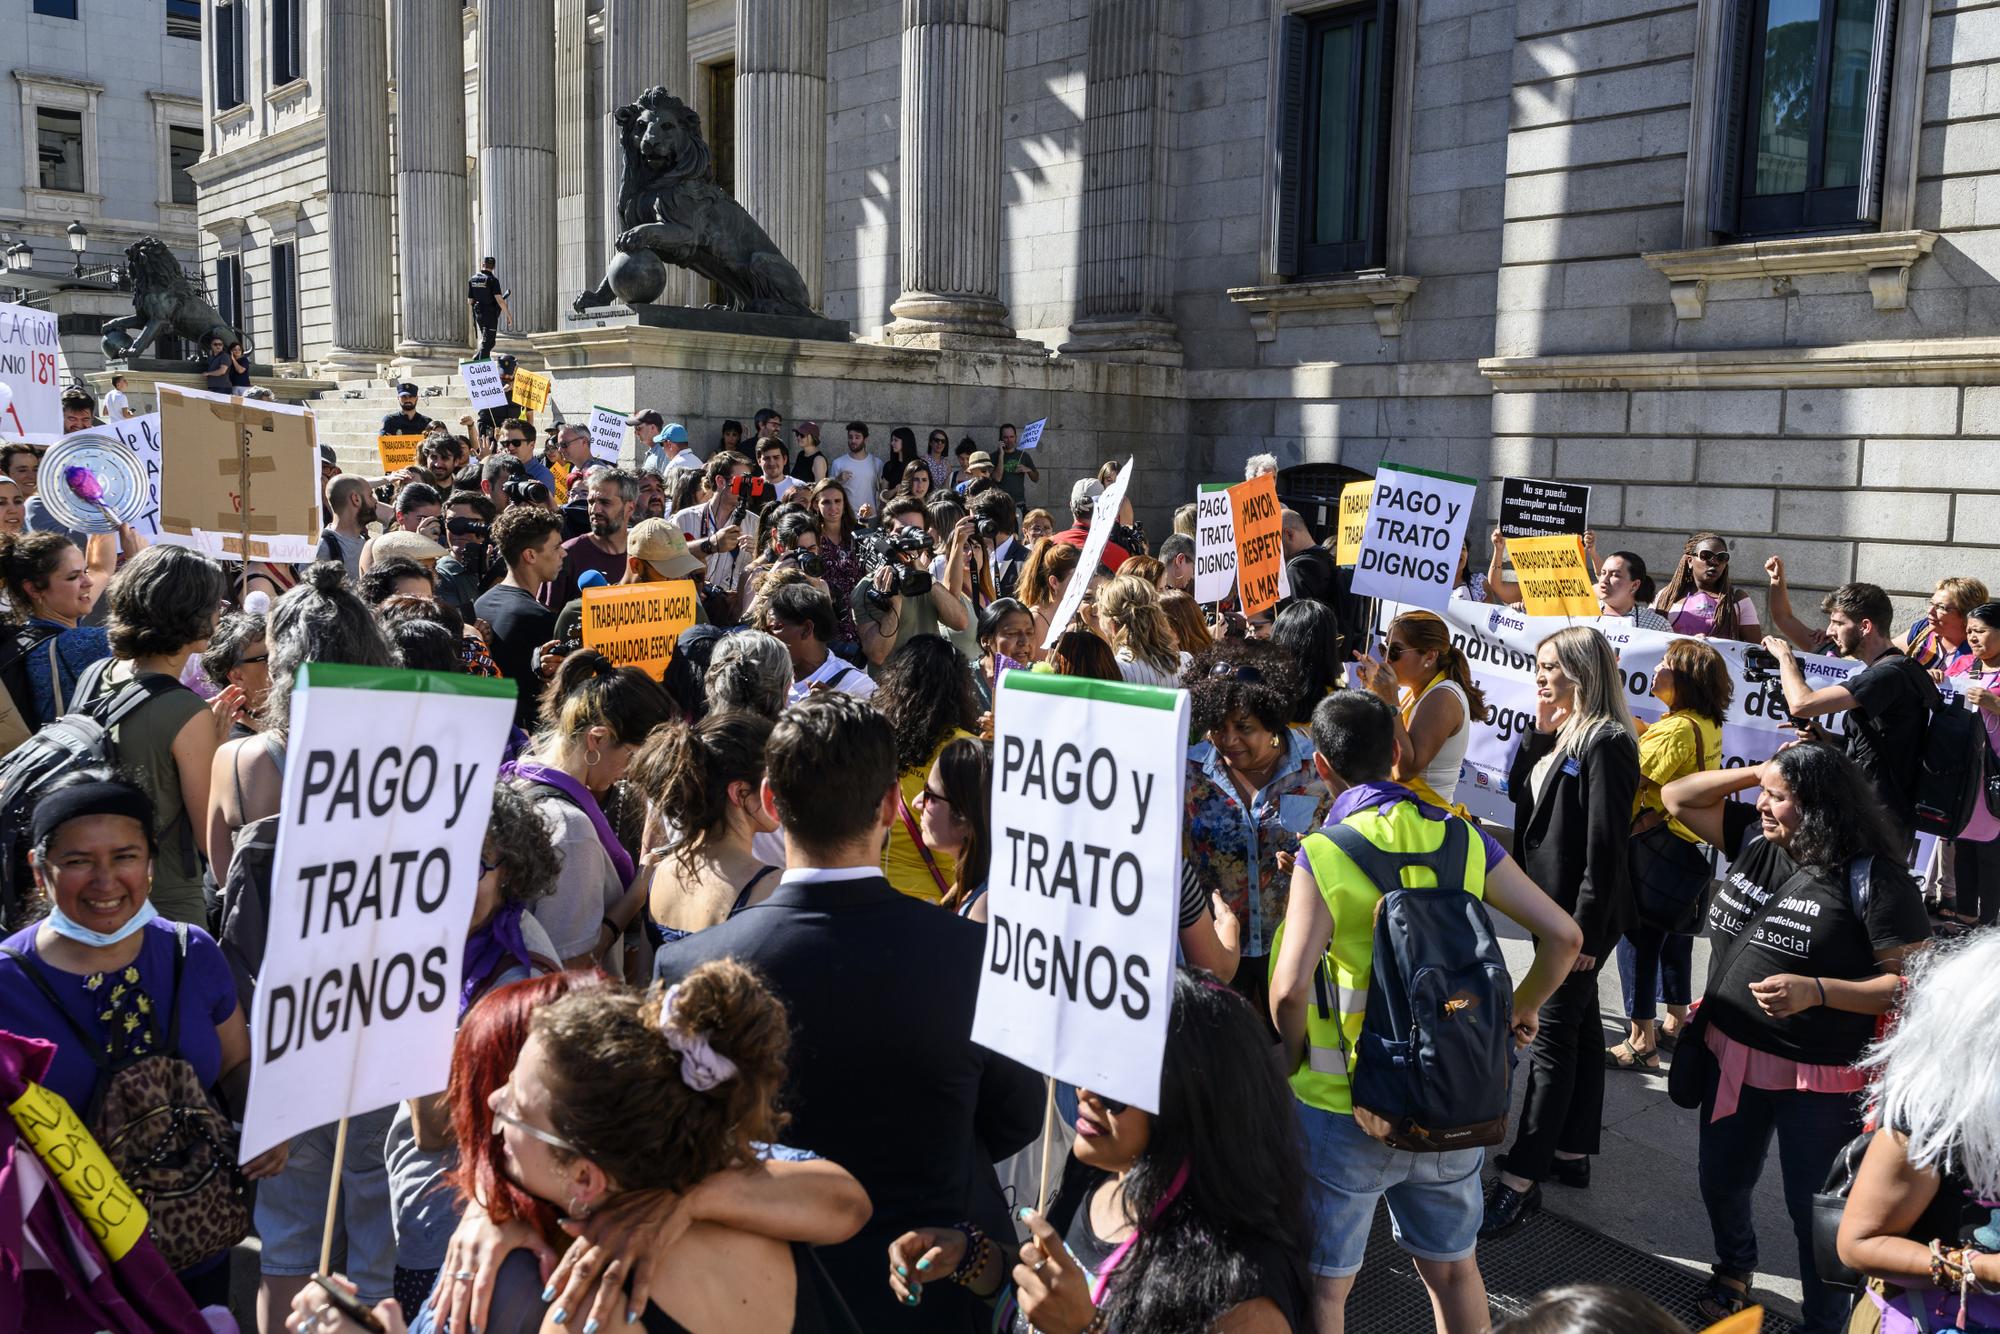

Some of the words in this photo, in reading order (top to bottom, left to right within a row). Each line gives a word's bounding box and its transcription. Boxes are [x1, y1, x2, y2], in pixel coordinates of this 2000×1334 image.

[31, 351, 55, 386] 189
[469, 365, 491, 375] Cuida
[472, 390, 479, 398] te
[480, 387, 504, 396] cuida.
[477, 376, 498, 387] quien
[598, 413, 622, 427] Cuida
[596, 439, 619, 451] cuida.
[600, 427, 621, 439] quien
[1523, 483, 1533, 494] No
[1534, 487, 1544, 495] se
[1545, 488, 1567, 499] puede
[1344, 494, 1373, 518] TRABAJA
[1376, 484, 1441, 516] PAGO
[1445, 502, 1461, 525] y
[1505, 497, 1547, 510] contemplar
[1548, 502, 1557, 511] un
[1559, 501, 1583, 514] futuro
[1519, 510, 1531, 520] sin
[1532, 513, 1565, 525] nosotras
[1201, 524, 1234, 547] TRATO
[1344, 526, 1364, 545] TRABA
[1376, 517, 1450, 551] TRATO
[1243, 530, 1281, 567] RESPETO
[1197, 551, 1235, 576] DIGNOS
[1360, 548, 1450, 584] DIGNOS
[1245, 580, 1260, 608] AL
[590, 601, 646, 632] TRABAJADORA
[648, 598, 662, 622] DEL
[1489, 612, 1525, 632] #FARTES
[1805, 663, 1849, 680] #FARTES
[297, 745, 439, 826] PAGO
[444, 762, 479, 829] y
[1002, 734, 1118, 811] PAGO
[1131, 770, 1154, 835] y
[1005, 827, 1144, 916] TRATO
[297, 847, 451, 941] TRATO
[1767, 931, 1811, 953] social
[990, 914, 1150, 1021] DIGNOS
[263, 945, 447, 1065] DIGNOS
